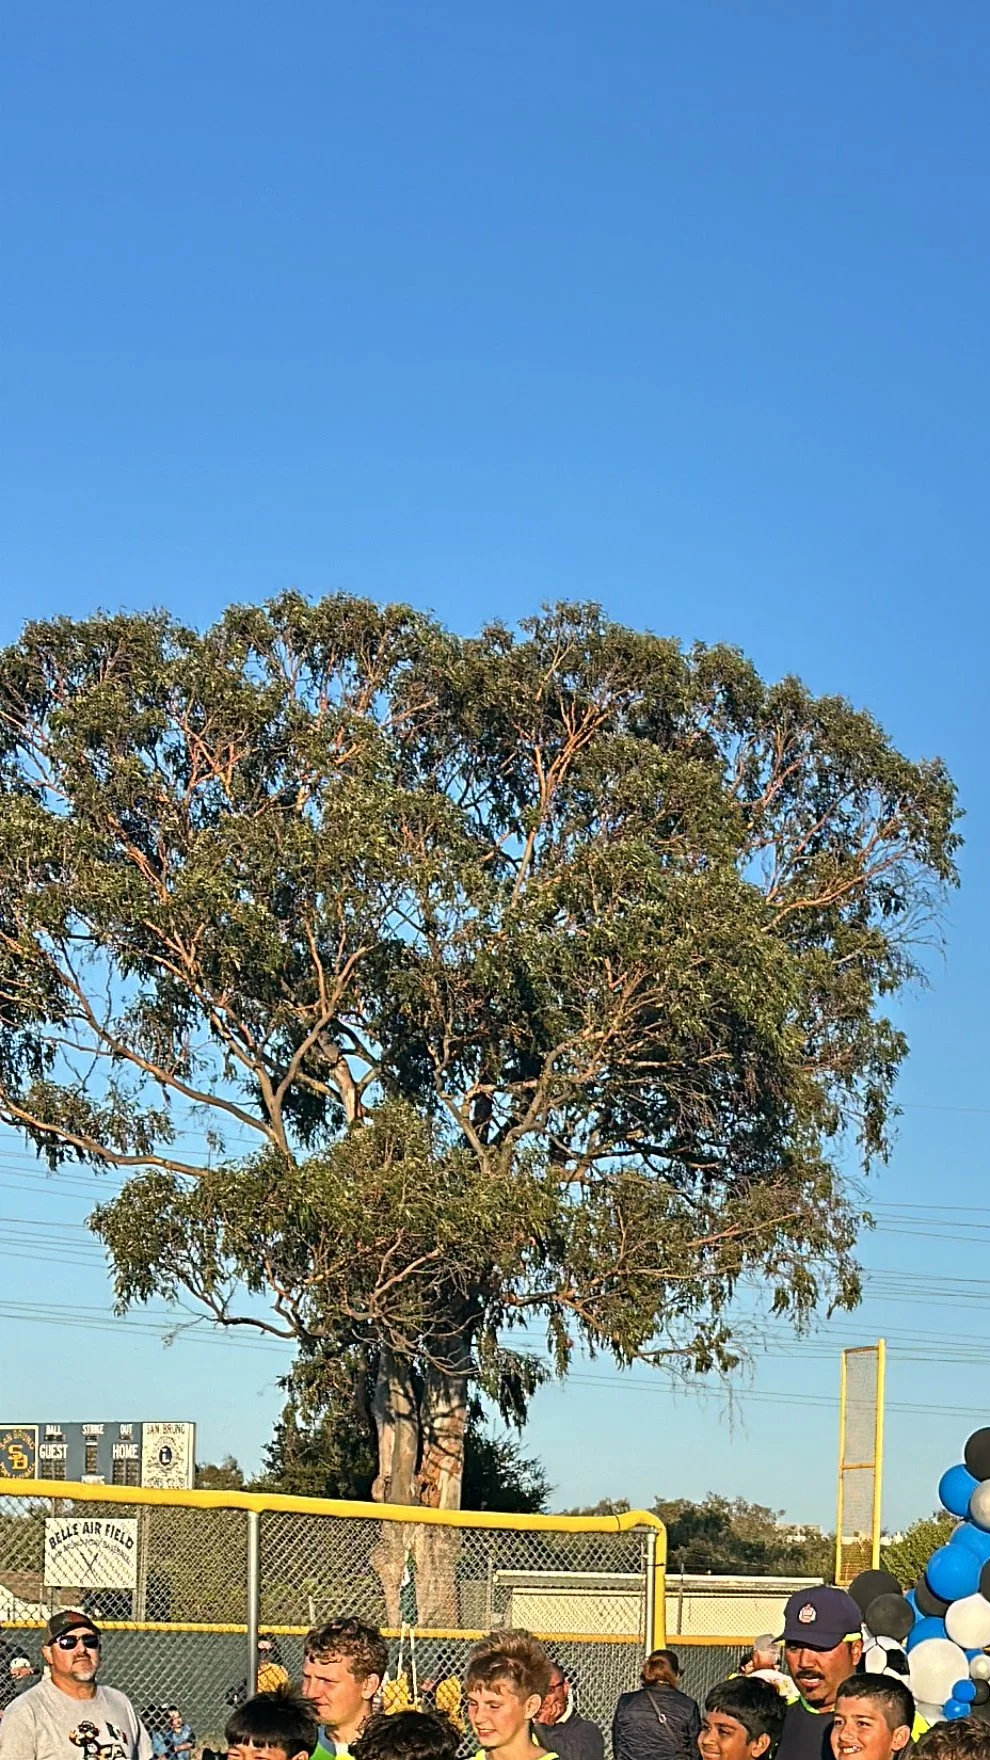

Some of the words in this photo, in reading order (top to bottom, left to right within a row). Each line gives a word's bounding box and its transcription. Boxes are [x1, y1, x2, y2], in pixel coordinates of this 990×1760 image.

[82, 1424, 104, 1435] STRIKE
[120, 1424, 133, 1435] OUT
[163, 1424, 186, 1434] BRUNO
[40, 1444, 68, 1459] GUEST
[113, 1444, 138, 1459] HOME
[49, 1523, 79, 1549] BELLE
[82, 1522, 102, 1535] AIR
[105, 1523, 134, 1550] FIELD
